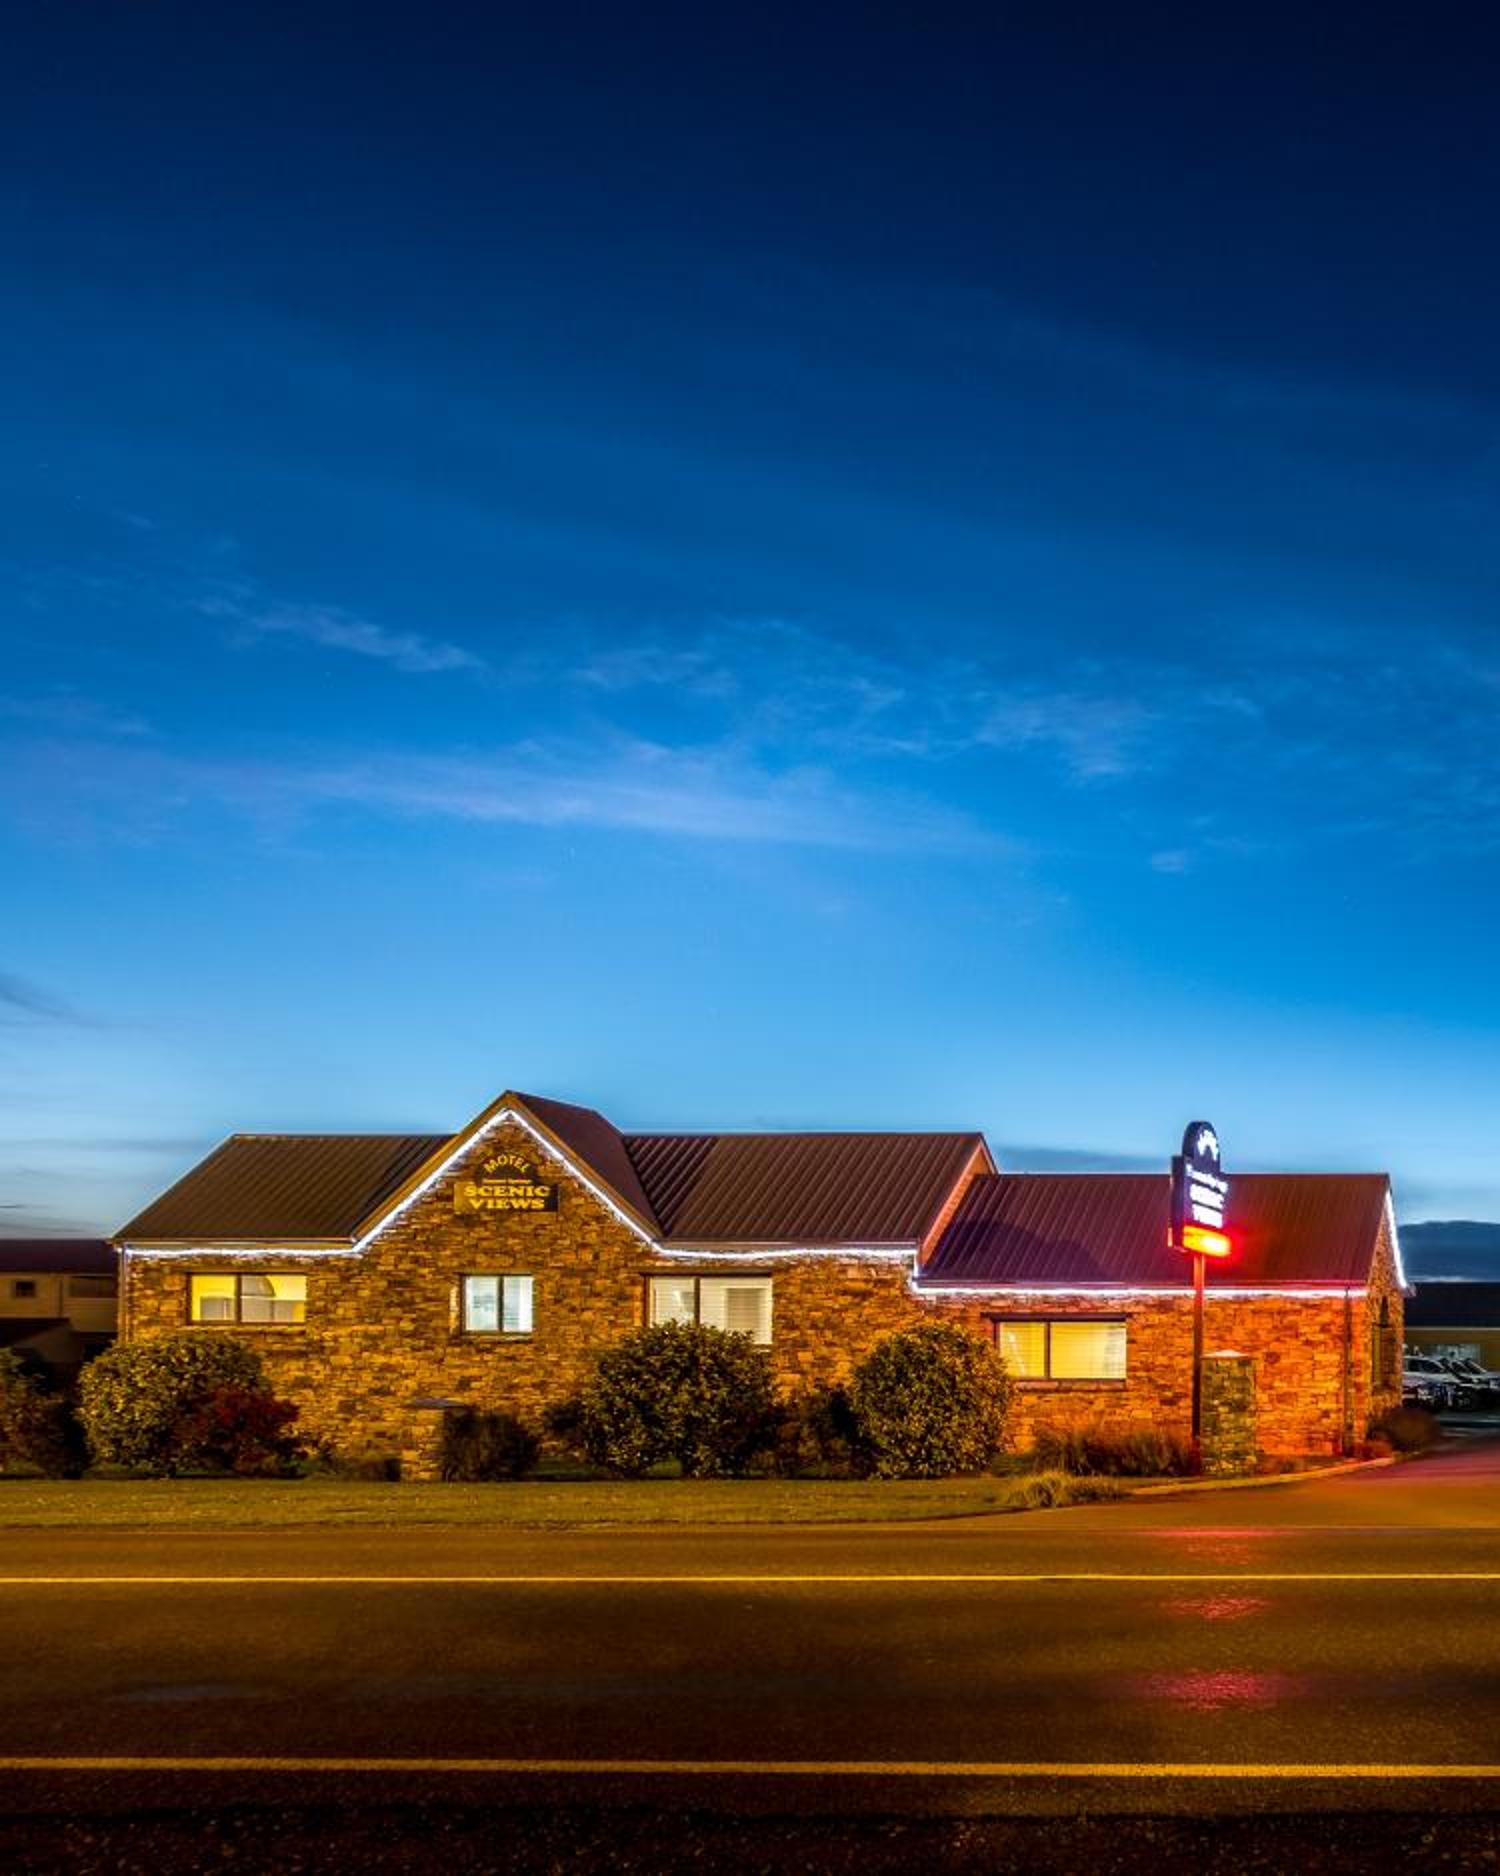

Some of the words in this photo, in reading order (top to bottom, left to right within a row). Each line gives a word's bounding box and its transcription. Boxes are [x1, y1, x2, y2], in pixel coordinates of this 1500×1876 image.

[483, 1154, 530, 1173] MOTEL
[464, 1185, 551, 1197] SCENIC
[469, 1199, 545, 1209] VIEWS
